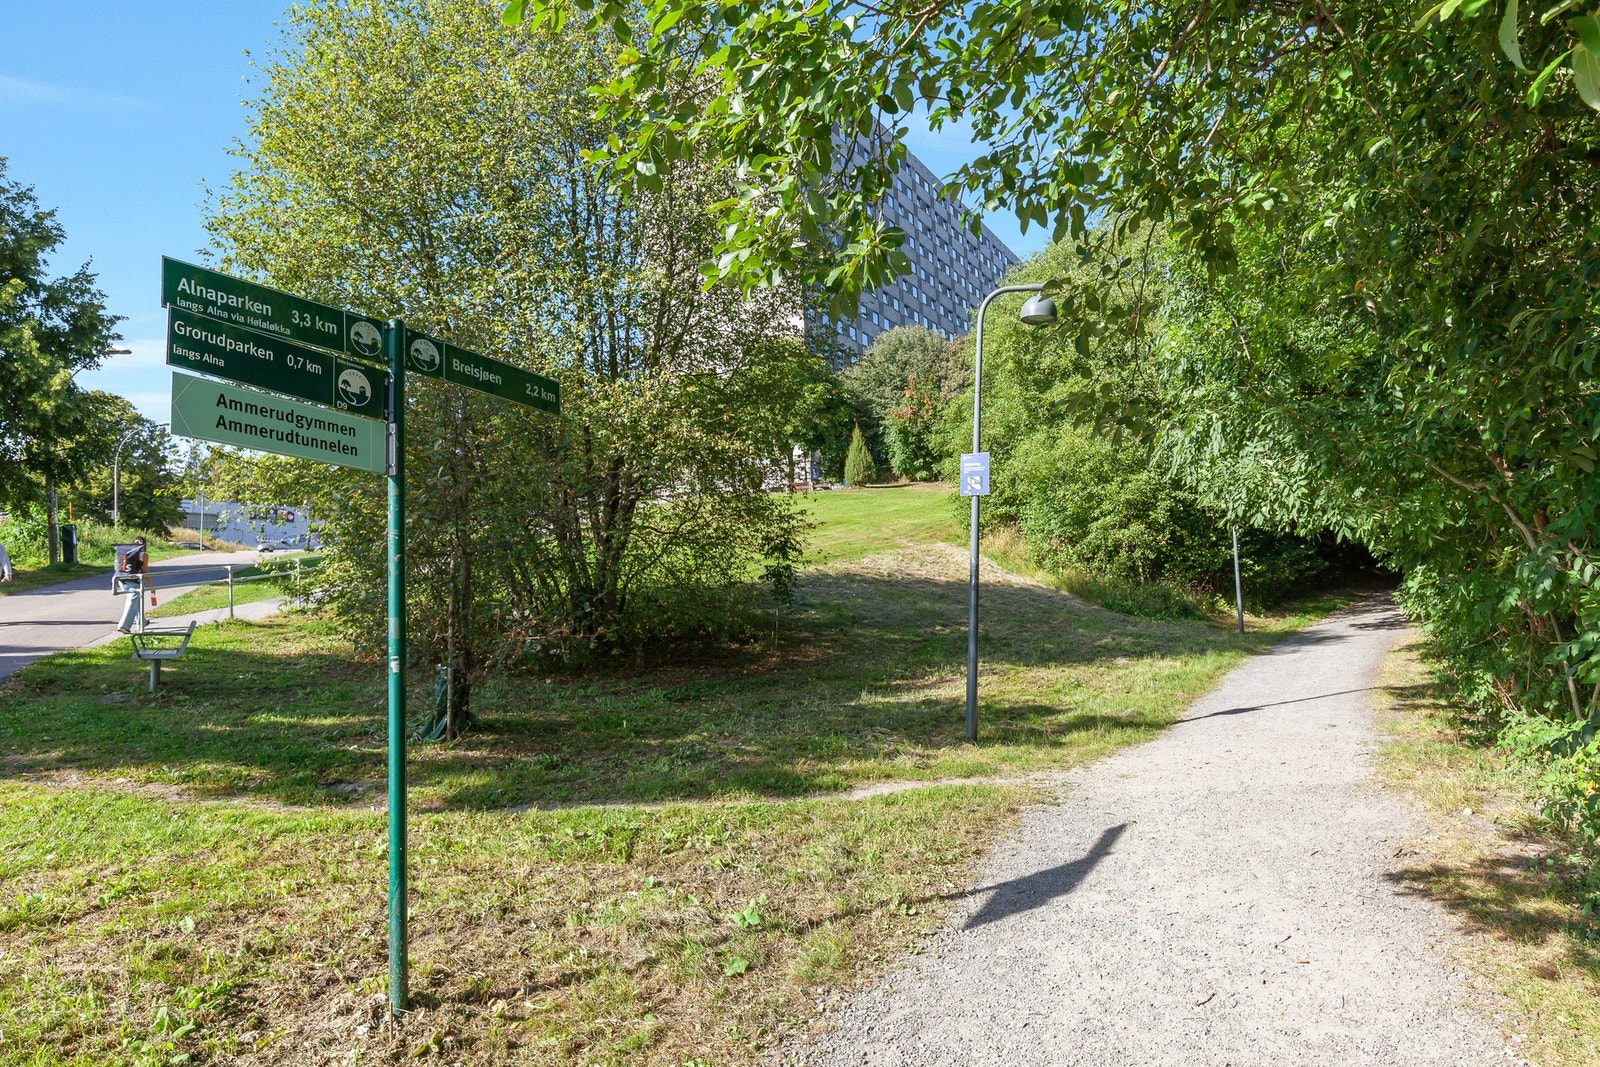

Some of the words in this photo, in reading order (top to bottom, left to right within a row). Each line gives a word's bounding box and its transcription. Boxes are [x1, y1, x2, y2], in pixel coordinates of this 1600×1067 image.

[176, 296, 204, 313] langs
[206, 305, 229, 319] Alna
[230, 312, 245, 322] via
[247, 315, 291, 335] Hølaløkka
[177, 277, 272, 317] Alnaparken
[291, 310, 311, 328] 3,3
[315, 315, 338, 335] km
[173, 343, 201, 361] langs
[203, 352, 225, 367] Alna
[174, 320, 274, 361] Grorudparken
[287, 354, 304, 370] 0,7
[306, 359, 322, 375] km
[452, 358, 502, 385] Breisjøen
[525, 383, 539, 398] 2,2
[541, 388, 556, 403] km
[216, 393, 356, 438] Ammerudgymmen
[336, 400, 348, 410] D9
[215, 414, 358, 457] Ammerudtunnelen
